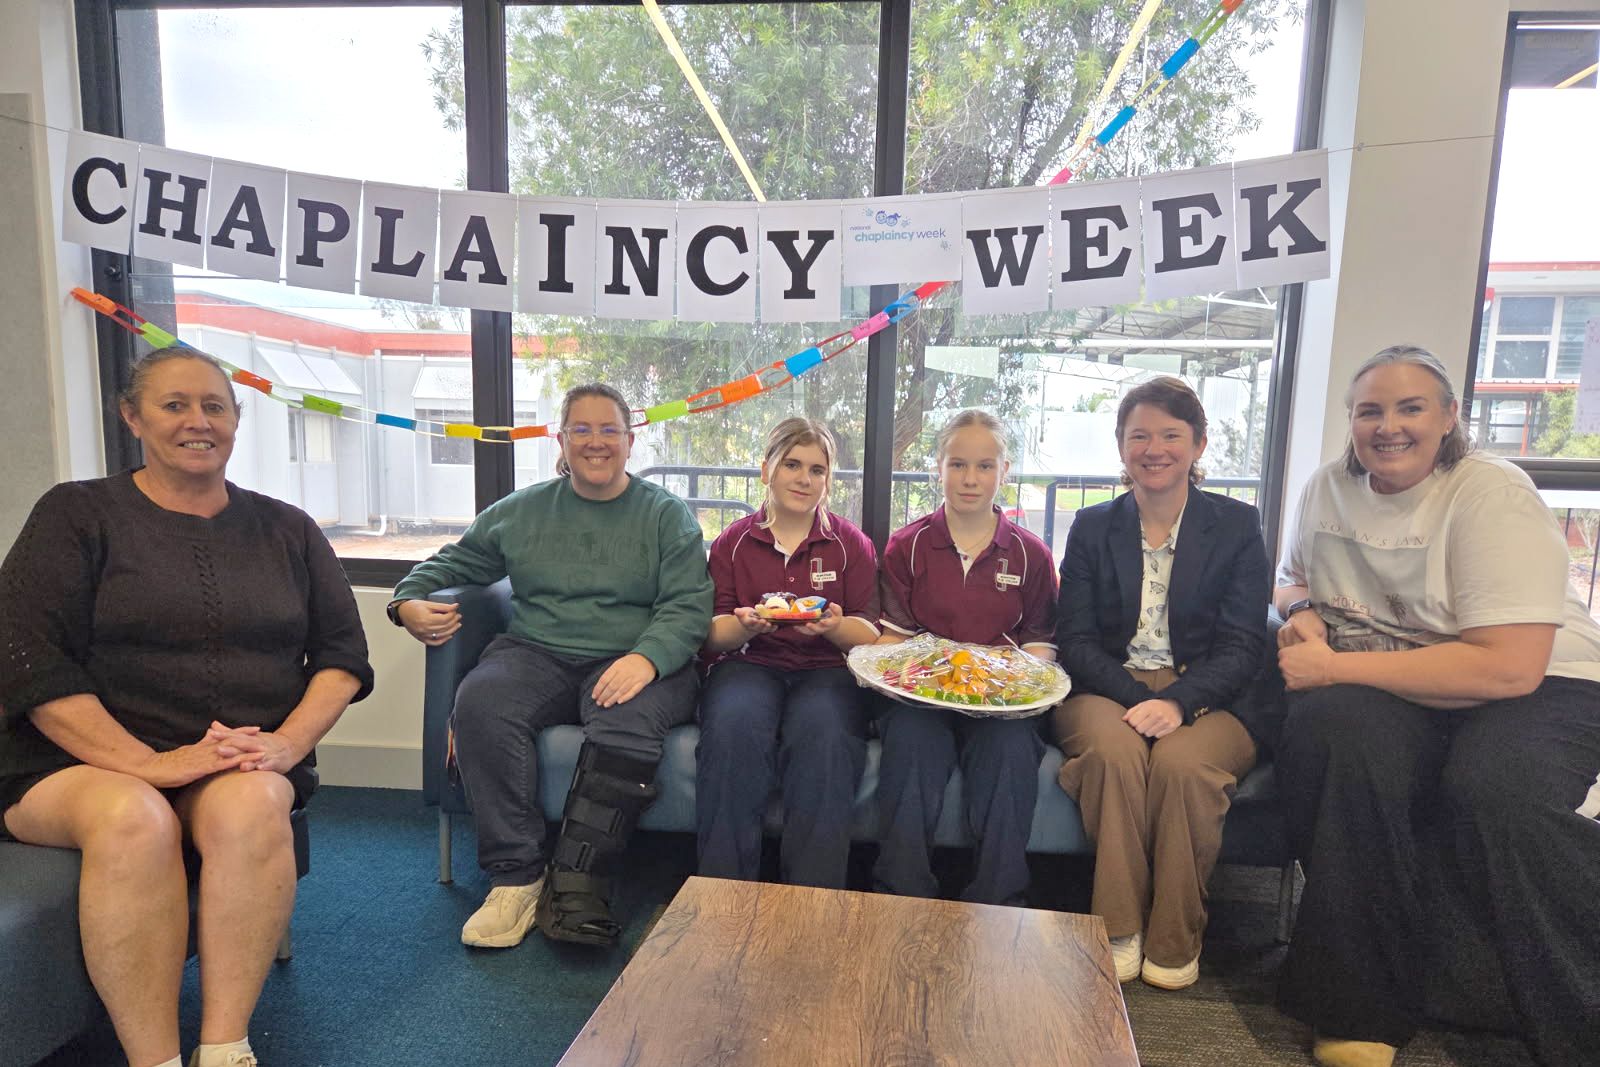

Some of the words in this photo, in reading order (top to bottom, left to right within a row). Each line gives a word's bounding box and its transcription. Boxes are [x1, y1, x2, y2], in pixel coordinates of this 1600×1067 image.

[71, 156, 835, 300] CHAPLAINCY
[966, 178, 1326, 289] WEEK
[854, 230, 914, 243] chaplaincy
[916, 228, 946, 239] week
